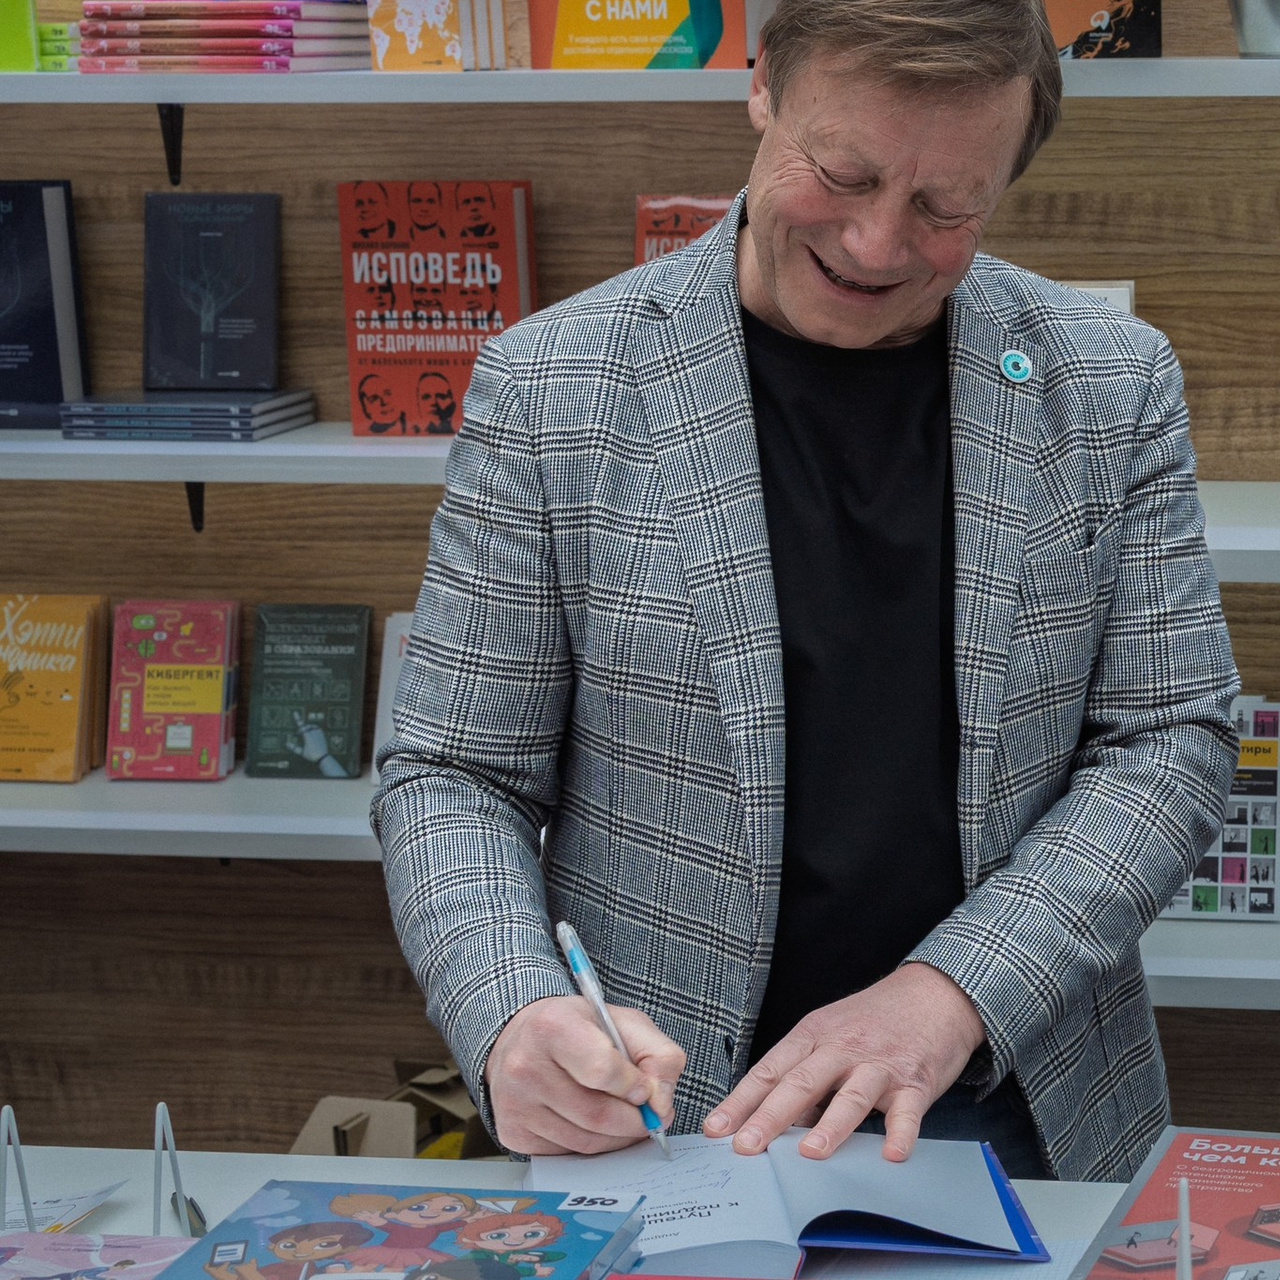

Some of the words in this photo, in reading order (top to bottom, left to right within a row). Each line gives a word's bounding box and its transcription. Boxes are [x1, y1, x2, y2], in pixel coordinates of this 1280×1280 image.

[585, 0, 601, 20] С
[606, 0, 668, 20] НАМИ
[352, 251, 502, 288] ИСПОВЕДЬ
[355, 309, 504, 331] САМОЗВАНЦА
[1182, 1152, 1260, 1168] чем
[1172, 1170, 1246, 1180] потенциале
